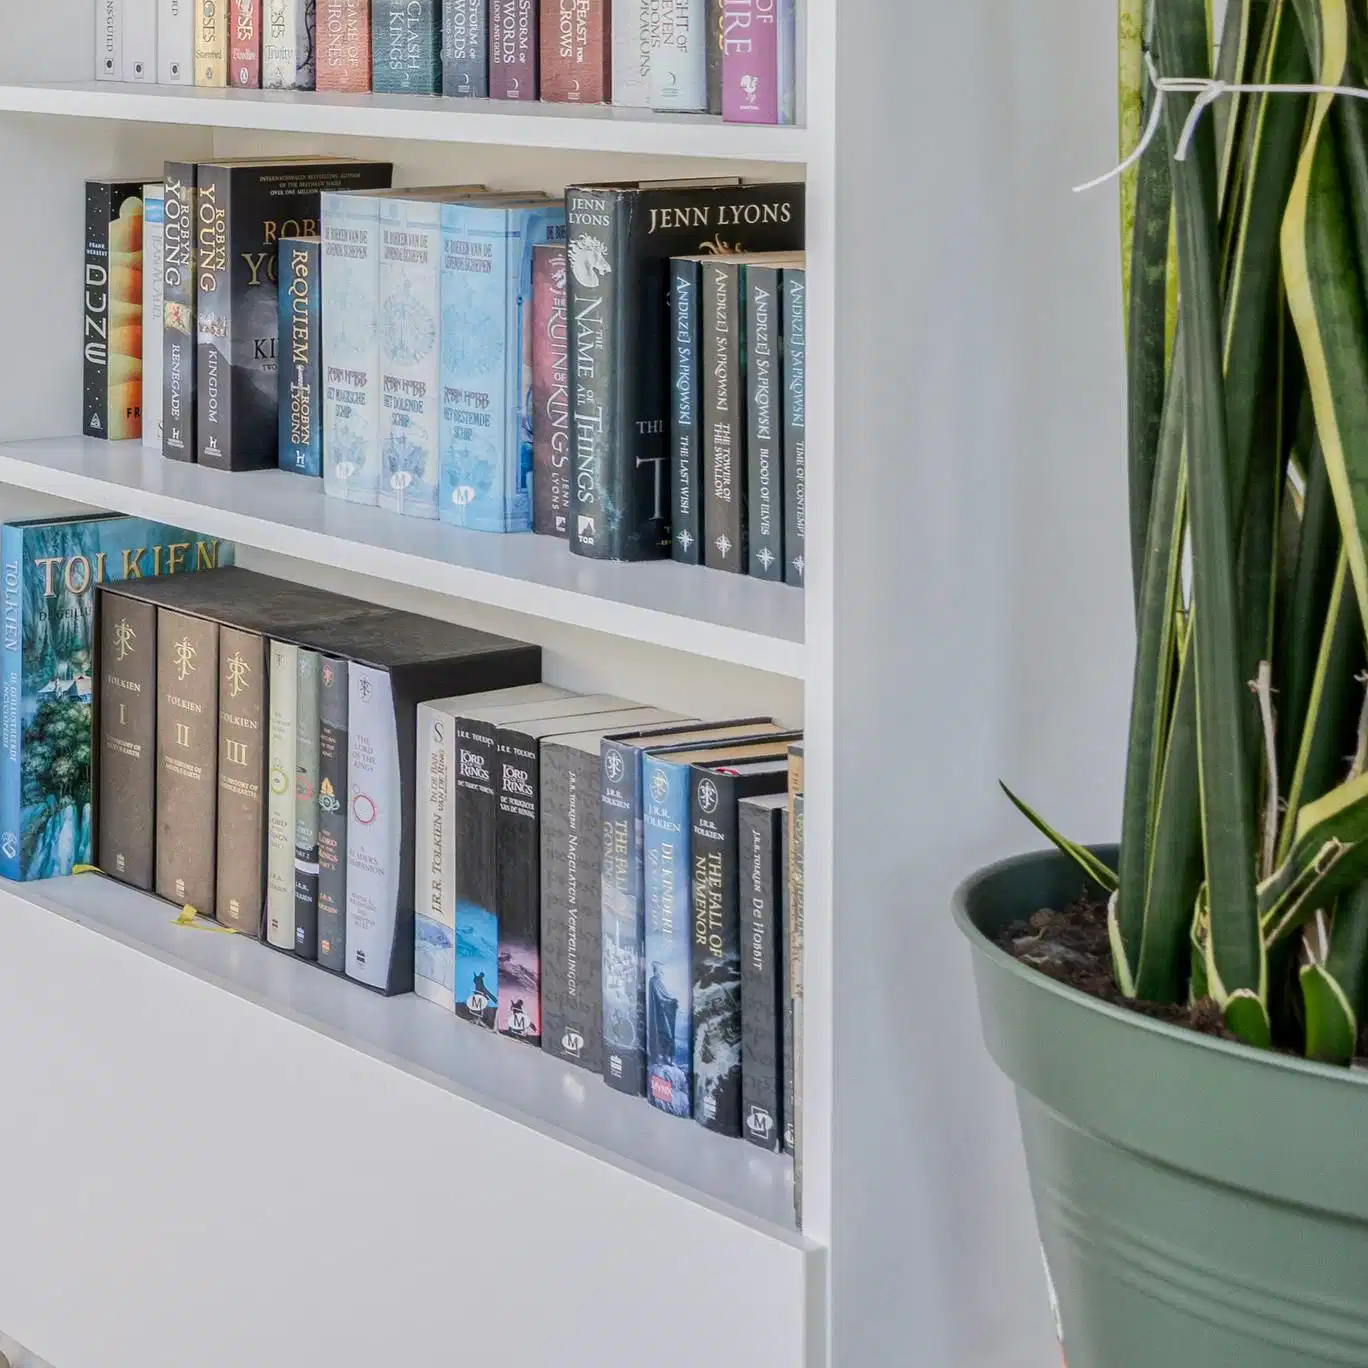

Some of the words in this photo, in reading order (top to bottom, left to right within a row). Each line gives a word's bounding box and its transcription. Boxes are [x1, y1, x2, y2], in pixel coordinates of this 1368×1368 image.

[389, 11, 405, 71] KINGS
[407, 0, 421, 71] CLASH
[518, 0, 530, 50] STORM
[577, 0, 589, 45] FEAST
[568, 213, 610, 227] LYONS
[571, 198, 606, 211] JENN
[648, 207, 710, 234] JENN
[717, 202, 792, 225] LYONS
[165, 180, 181, 287] YOUNG
[180, 203, 189, 266] ROBYN
[199, 183, 217, 293] YOUNG
[215, 208, 225, 272] ROBYN
[676, 276, 691, 344] ANDRZEJ
[714, 268, 729, 334] ANDRZEJ
[752, 285, 771, 355] ANDRZEJ
[789, 279, 805, 348] ANDRZEJ
[573, 295, 603, 379] NAME
[172, 343, 181, 418] RENEGADE
[209, 349, 217, 423] KINGDOM
[675, 346, 691, 426] SAPKOWSKI
[714, 335, 729, 412] SAPKOWSKI
[753, 357, 771, 441] SAPKOWSKI
[789, 349, 805, 429] SAPKOWSKI
[574, 405, 603, 504] THINGS
[680, 435, 688, 456] THE
[680, 459, 689, 485] LAST
[722, 450, 730, 484] TOWER
[761, 448, 770, 485] BLOOD
[713, 446, 722, 499] SWALLOW
[679, 486, 688, 514] WISH
[577, 536, 594, 545] TOR
[34, 539, 221, 600] TOLKIEN
[4, 560, 18, 652] TOLKIEN
[107, 674, 141, 692] TOLKIEN
[166, 695, 202, 713] TOLKIEN
[226, 738, 248, 766] III
[460, 749, 485, 767] LORD
[460, 763, 489, 781] RINGS
[502, 764, 528, 781] LORD
[502, 777, 533, 797] RINGS
[431, 813, 443, 875] TOLKIEN
[708, 852, 722, 887] THE
[708, 891, 722, 929] FALL
[708, 934, 723, 958] OF
